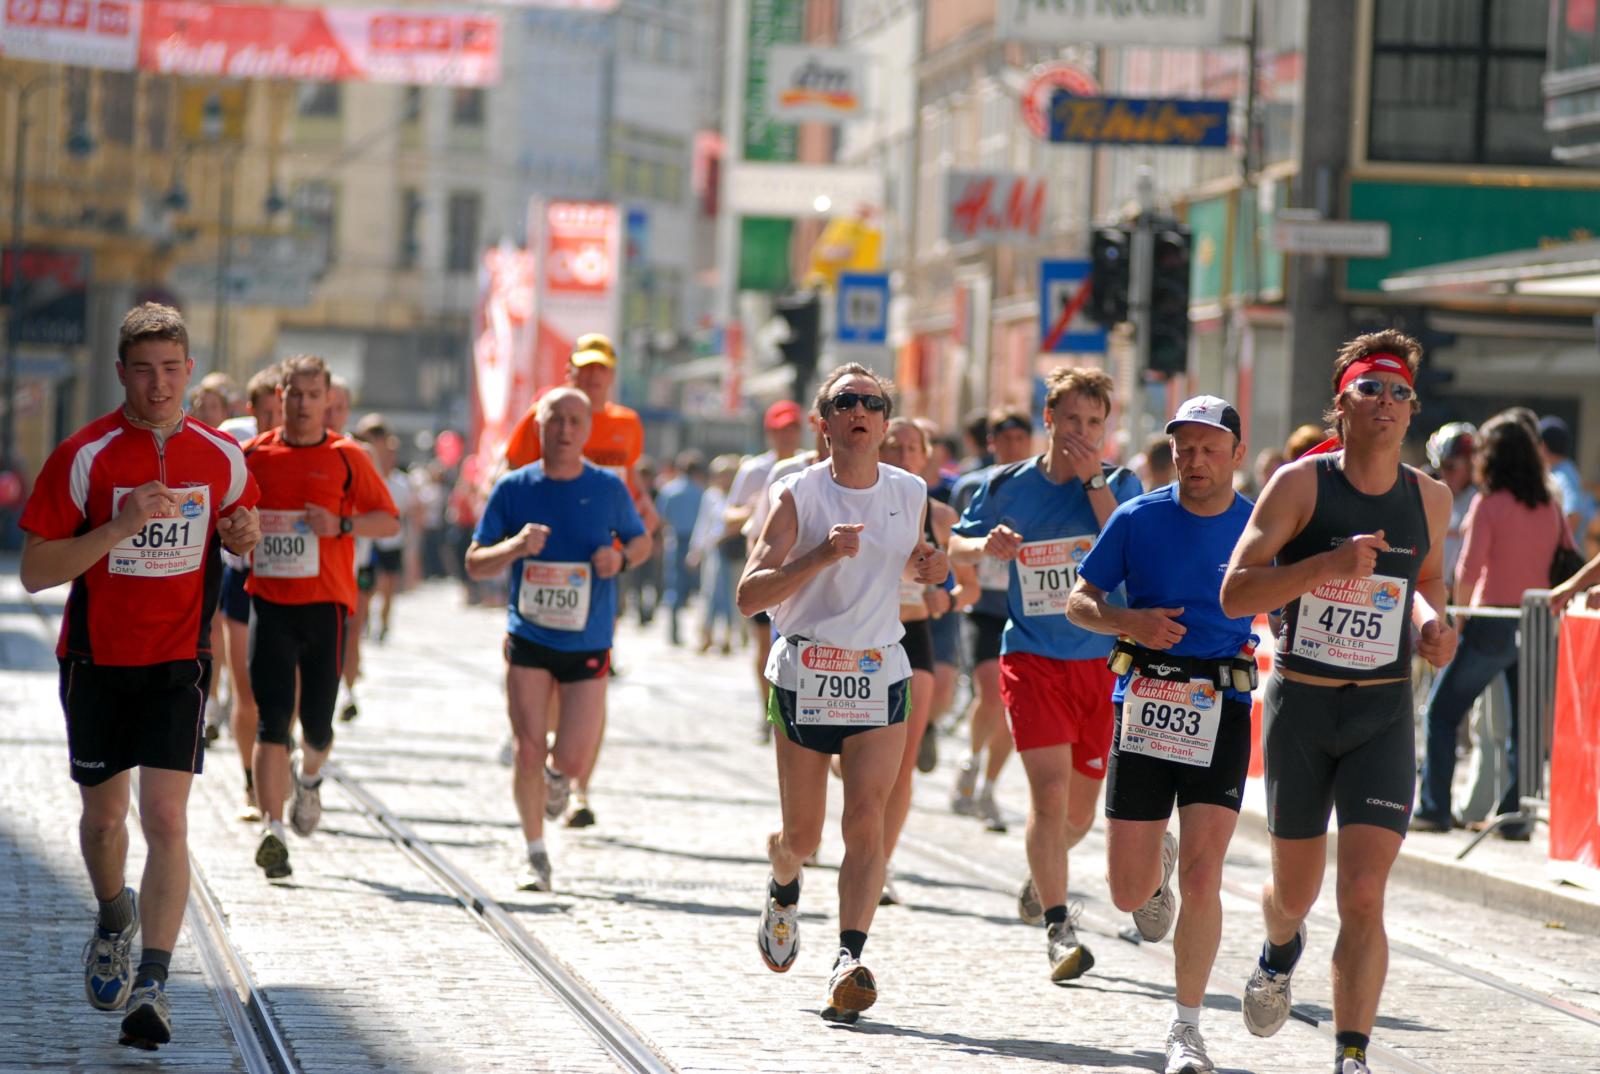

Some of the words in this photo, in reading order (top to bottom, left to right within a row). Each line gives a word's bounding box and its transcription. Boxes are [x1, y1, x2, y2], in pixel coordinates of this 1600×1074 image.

[11, 0, 85, 25] ORF
[1056, 101, 1219, 142] Tchibo
[132, 521, 190, 548] 3641
[263, 536, 305, 556] 5030
[140, 550, 181, 558] STEPHAN
[114, 566, 136, 574] OMV
[144, 559, 187, 570] Oberbank
[1034, 567, 1078, 590] 701
[1348, 579, 1371, 591] LINZ
[533, 587, 579, 609] 4750
[1314, 587, 1368, 604] MARATHON
[1319, 605, 1383, 640] 4755
[1327, 636, 1364, 649] WALTER
[836, 650, 854, 660] LINZ
[1298, 648, 1320, 659] OMV
[1327, 648, 1377, 664] Oberbank
[808, 657, 854, 671] MARATHON
[815, 674, 871, 699] 7908
[1167, 681, 1189, 693] LINZ
[1136, 686, 1187, 703] MARATHON
[826, 700, 856, 708] GEORG
[828, 710, 871, 719] Oberbank
[1141, 701, 1202, 736] 6933
[1134, 727, 1147, 736] OMV
[1147, 730, 1159, 738] Linz
[1160, 732, 1180, 742] Donau
[1181, 737, 1209, 748] Marathon
[1125, 743, 1145, 753] OMV
[1150, 741, 1195, 757] Oberbank
[72, 758, 106, 769] LEGEA
[1366, 797, 1405, 812] cocoon
